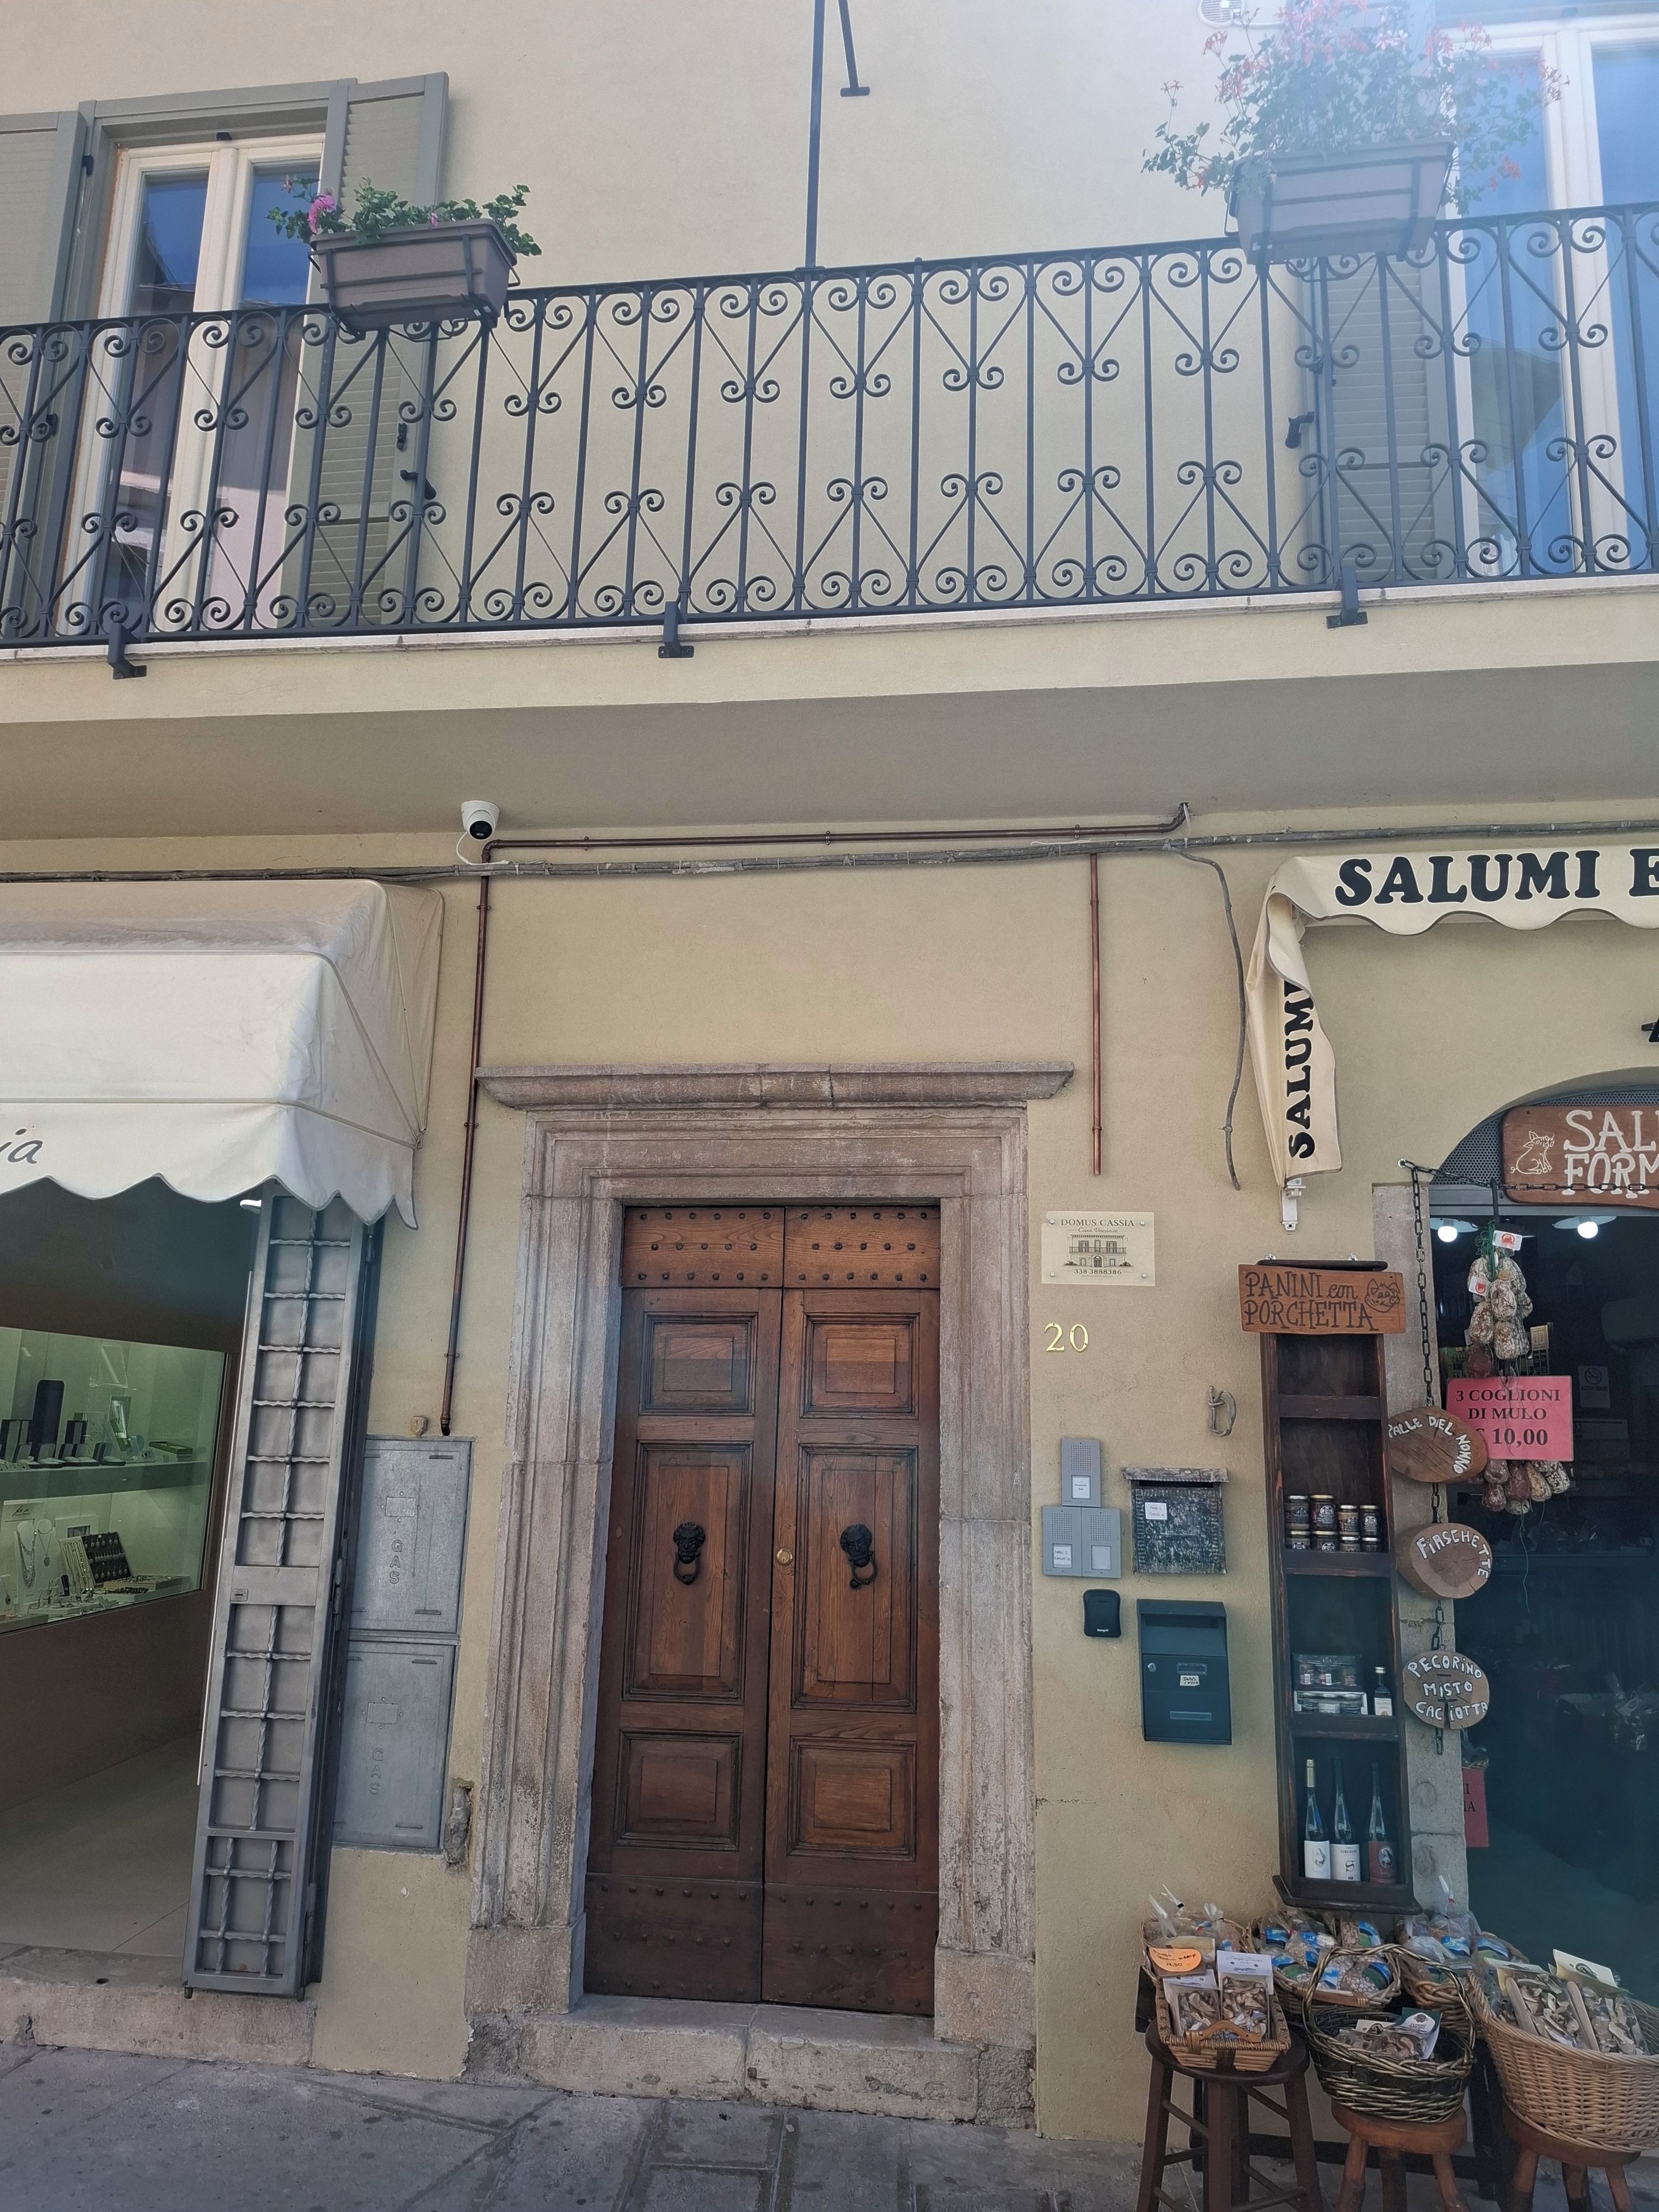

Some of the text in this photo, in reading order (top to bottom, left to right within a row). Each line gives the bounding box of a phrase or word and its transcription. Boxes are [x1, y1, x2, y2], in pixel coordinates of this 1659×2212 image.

[1335, 850, 1601, 907] SALUMI
[1563, 1109, 1659, 1152] SAL
[1060, 1218, 1097, 1226] DOMUS
[1244, 1271, 1322, 1300] PANINI
[1244, 1299, 1380, 1332] PORCHETTA
[1044, 1322, 1089, 1353] 20
[1455, 1388, 1561, 1402] 3 COGLIONI
[1388, 1417, 1423, 1438] PALLE
[1467, 1407, 1547, 1421] DI MULO
[1492, 1427, 1548, 1448] 10,00
[389, 1539, 403, 1585] GAS
[370, 1747, 383, 1796] GAS
